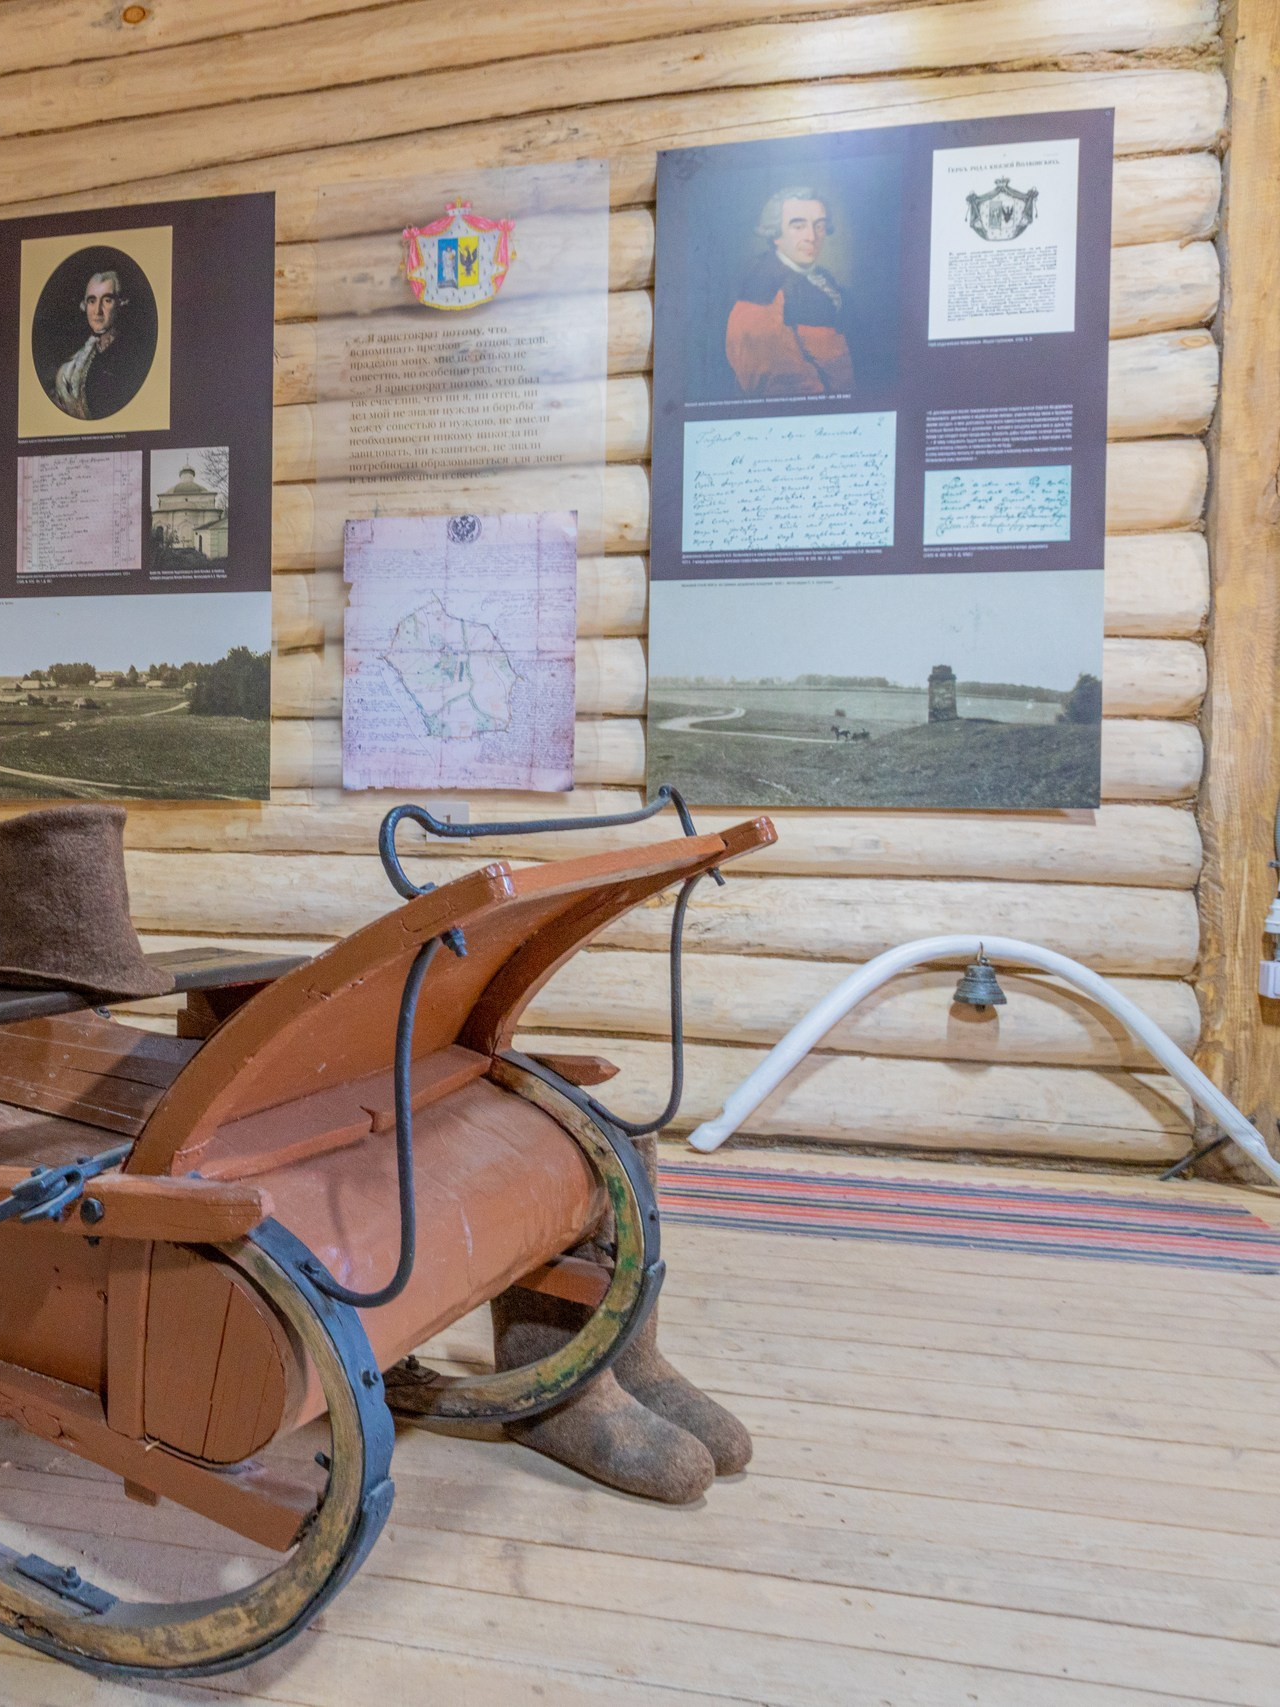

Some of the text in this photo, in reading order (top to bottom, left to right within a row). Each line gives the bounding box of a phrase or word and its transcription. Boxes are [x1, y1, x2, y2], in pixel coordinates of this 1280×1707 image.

[377, 326, 508, 344] аристократ потому, что
[350, 336, 548, 357] вспоминать предков отцов, дедов,
[350, 351, 526, 370] прадедов моих, мне не только не
[350, 364, 526, 383] совестно, но особенно радостно.
[375, 384, 382, 394] Я
[384, 382, 446, 395] аристократ
[450, 380, 493, 390] потому,
[496, 378, 515, 386] что
[518, 374, 540, 384] был
[351, 400, 368, 408] так
[370, 398, 421, 407] счастлив,
[424, 395, 442, 403] что
[446, 394, 460, 402] ни
[474, 392, 488, 400] ни
[492, 390, 520, 400] отец,
[350, 412, 366, 421] дед
[370, 408, 390, 419] мой
[393, 410, 406, 418] не
[408, 408, 440, 416] знали
[442, 406, 479, 416] нужды
[492, 400, 534, 413] борьбы
[350, 415, 550, 434] между совестью и нуждою, не имели
[350, 429, 538, 446] необходимости никому никогда ни
[348, 442, 540, 459] завидовать, ни кланяться, не знали
[350, 454, 562, 472] потребности образовываться для денег
[350, 472, 448, 484] и для положения в
